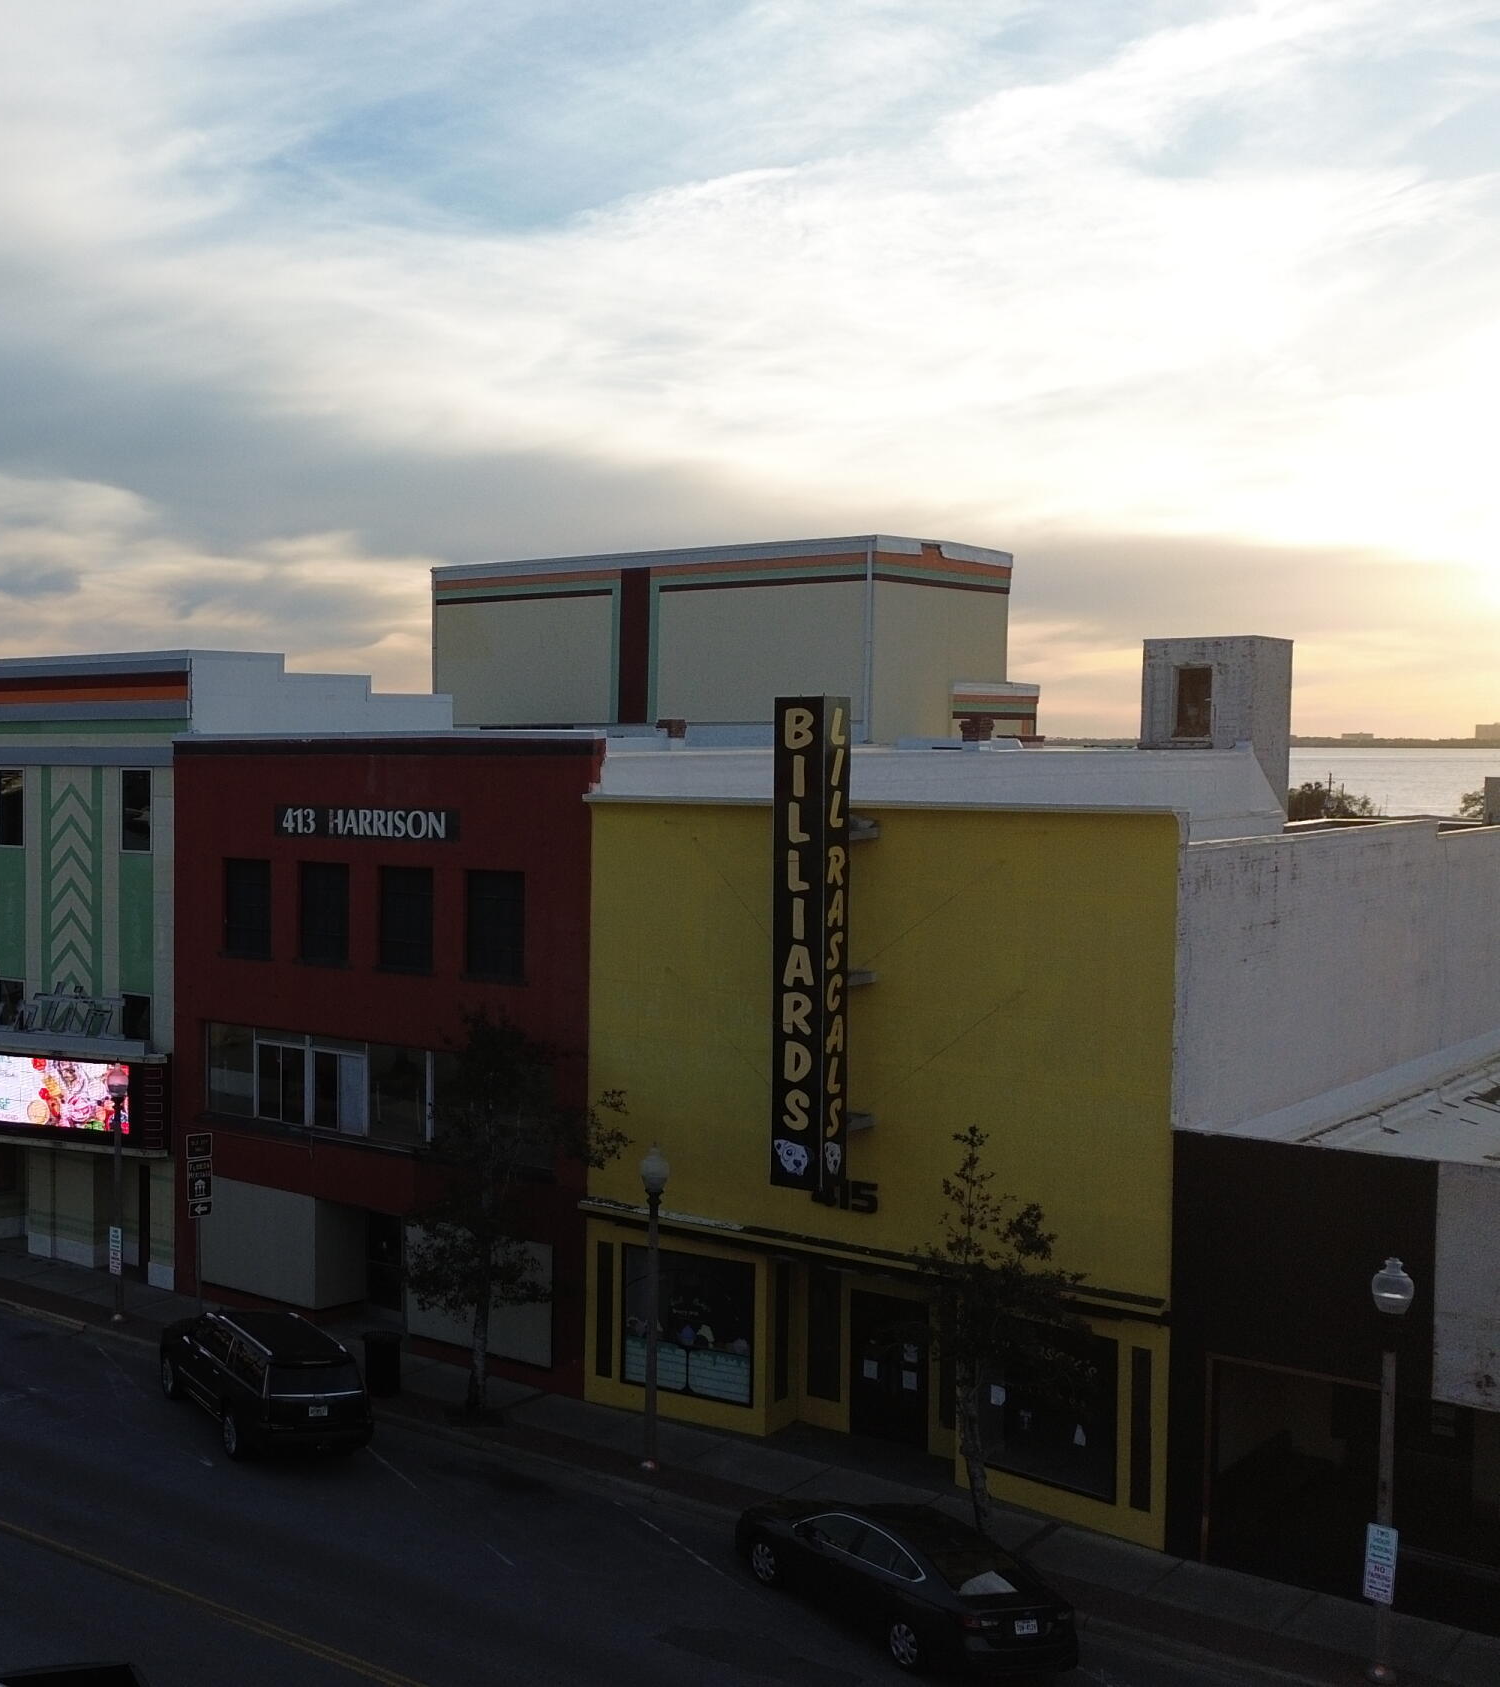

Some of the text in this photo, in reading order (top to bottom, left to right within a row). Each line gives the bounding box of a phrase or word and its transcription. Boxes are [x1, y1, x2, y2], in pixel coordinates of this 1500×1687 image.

[282, 808, 446, 838] 413 HARRISON
[782, 707, 814, 1132] BILLIARDS
[825, 707, 846, 1139] LIL RASCALS
[1374, 1565, 1386, 1574] NO
